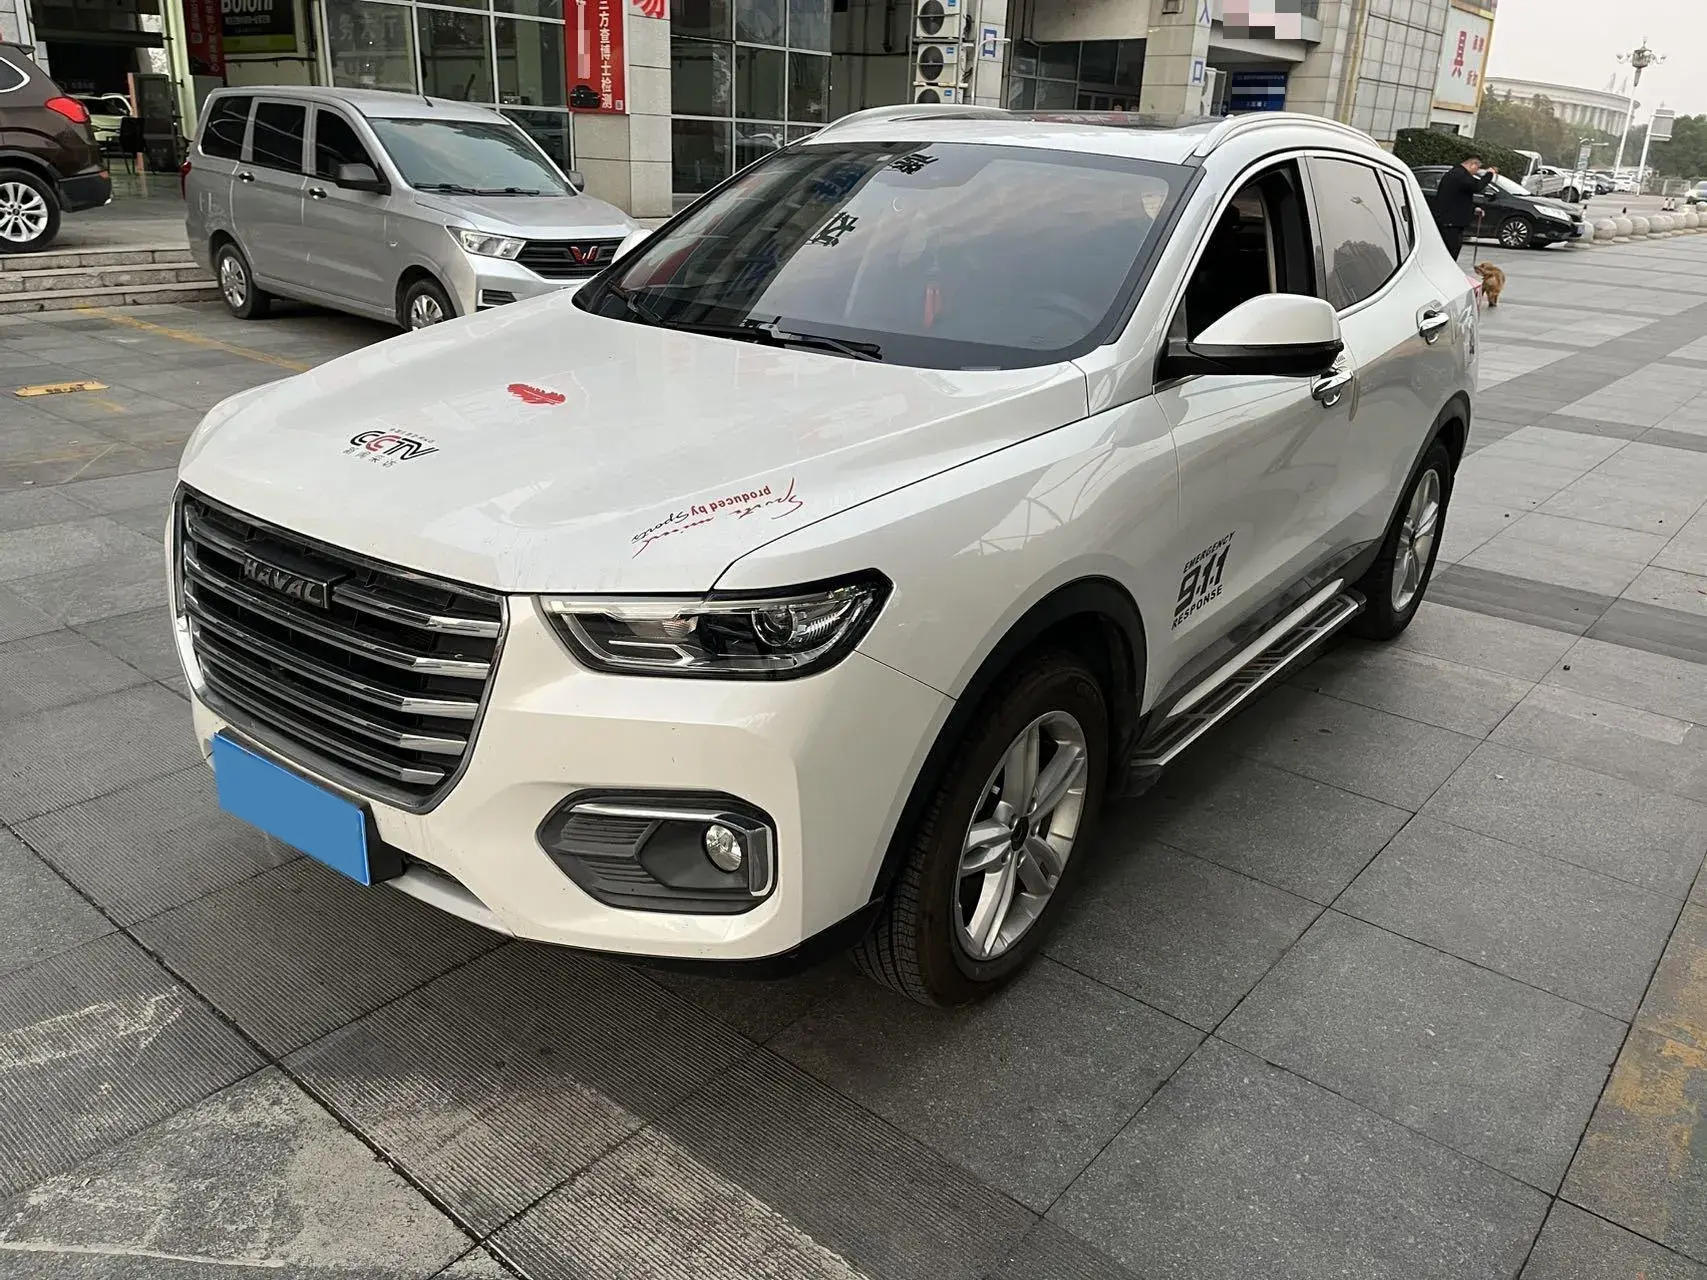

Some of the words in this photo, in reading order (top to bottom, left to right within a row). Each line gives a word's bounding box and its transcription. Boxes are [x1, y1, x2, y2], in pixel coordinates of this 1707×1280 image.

[350, 430, 439, 460] CCTV
[690, 505, 708, 516] by
[710, 485, 772, 512] produced
[1183, 530, 1236, 574] EMERGENCY
[244, 558, 325, 608] HAVAL
[1171, 584, 1223, 631] RESPONSE
